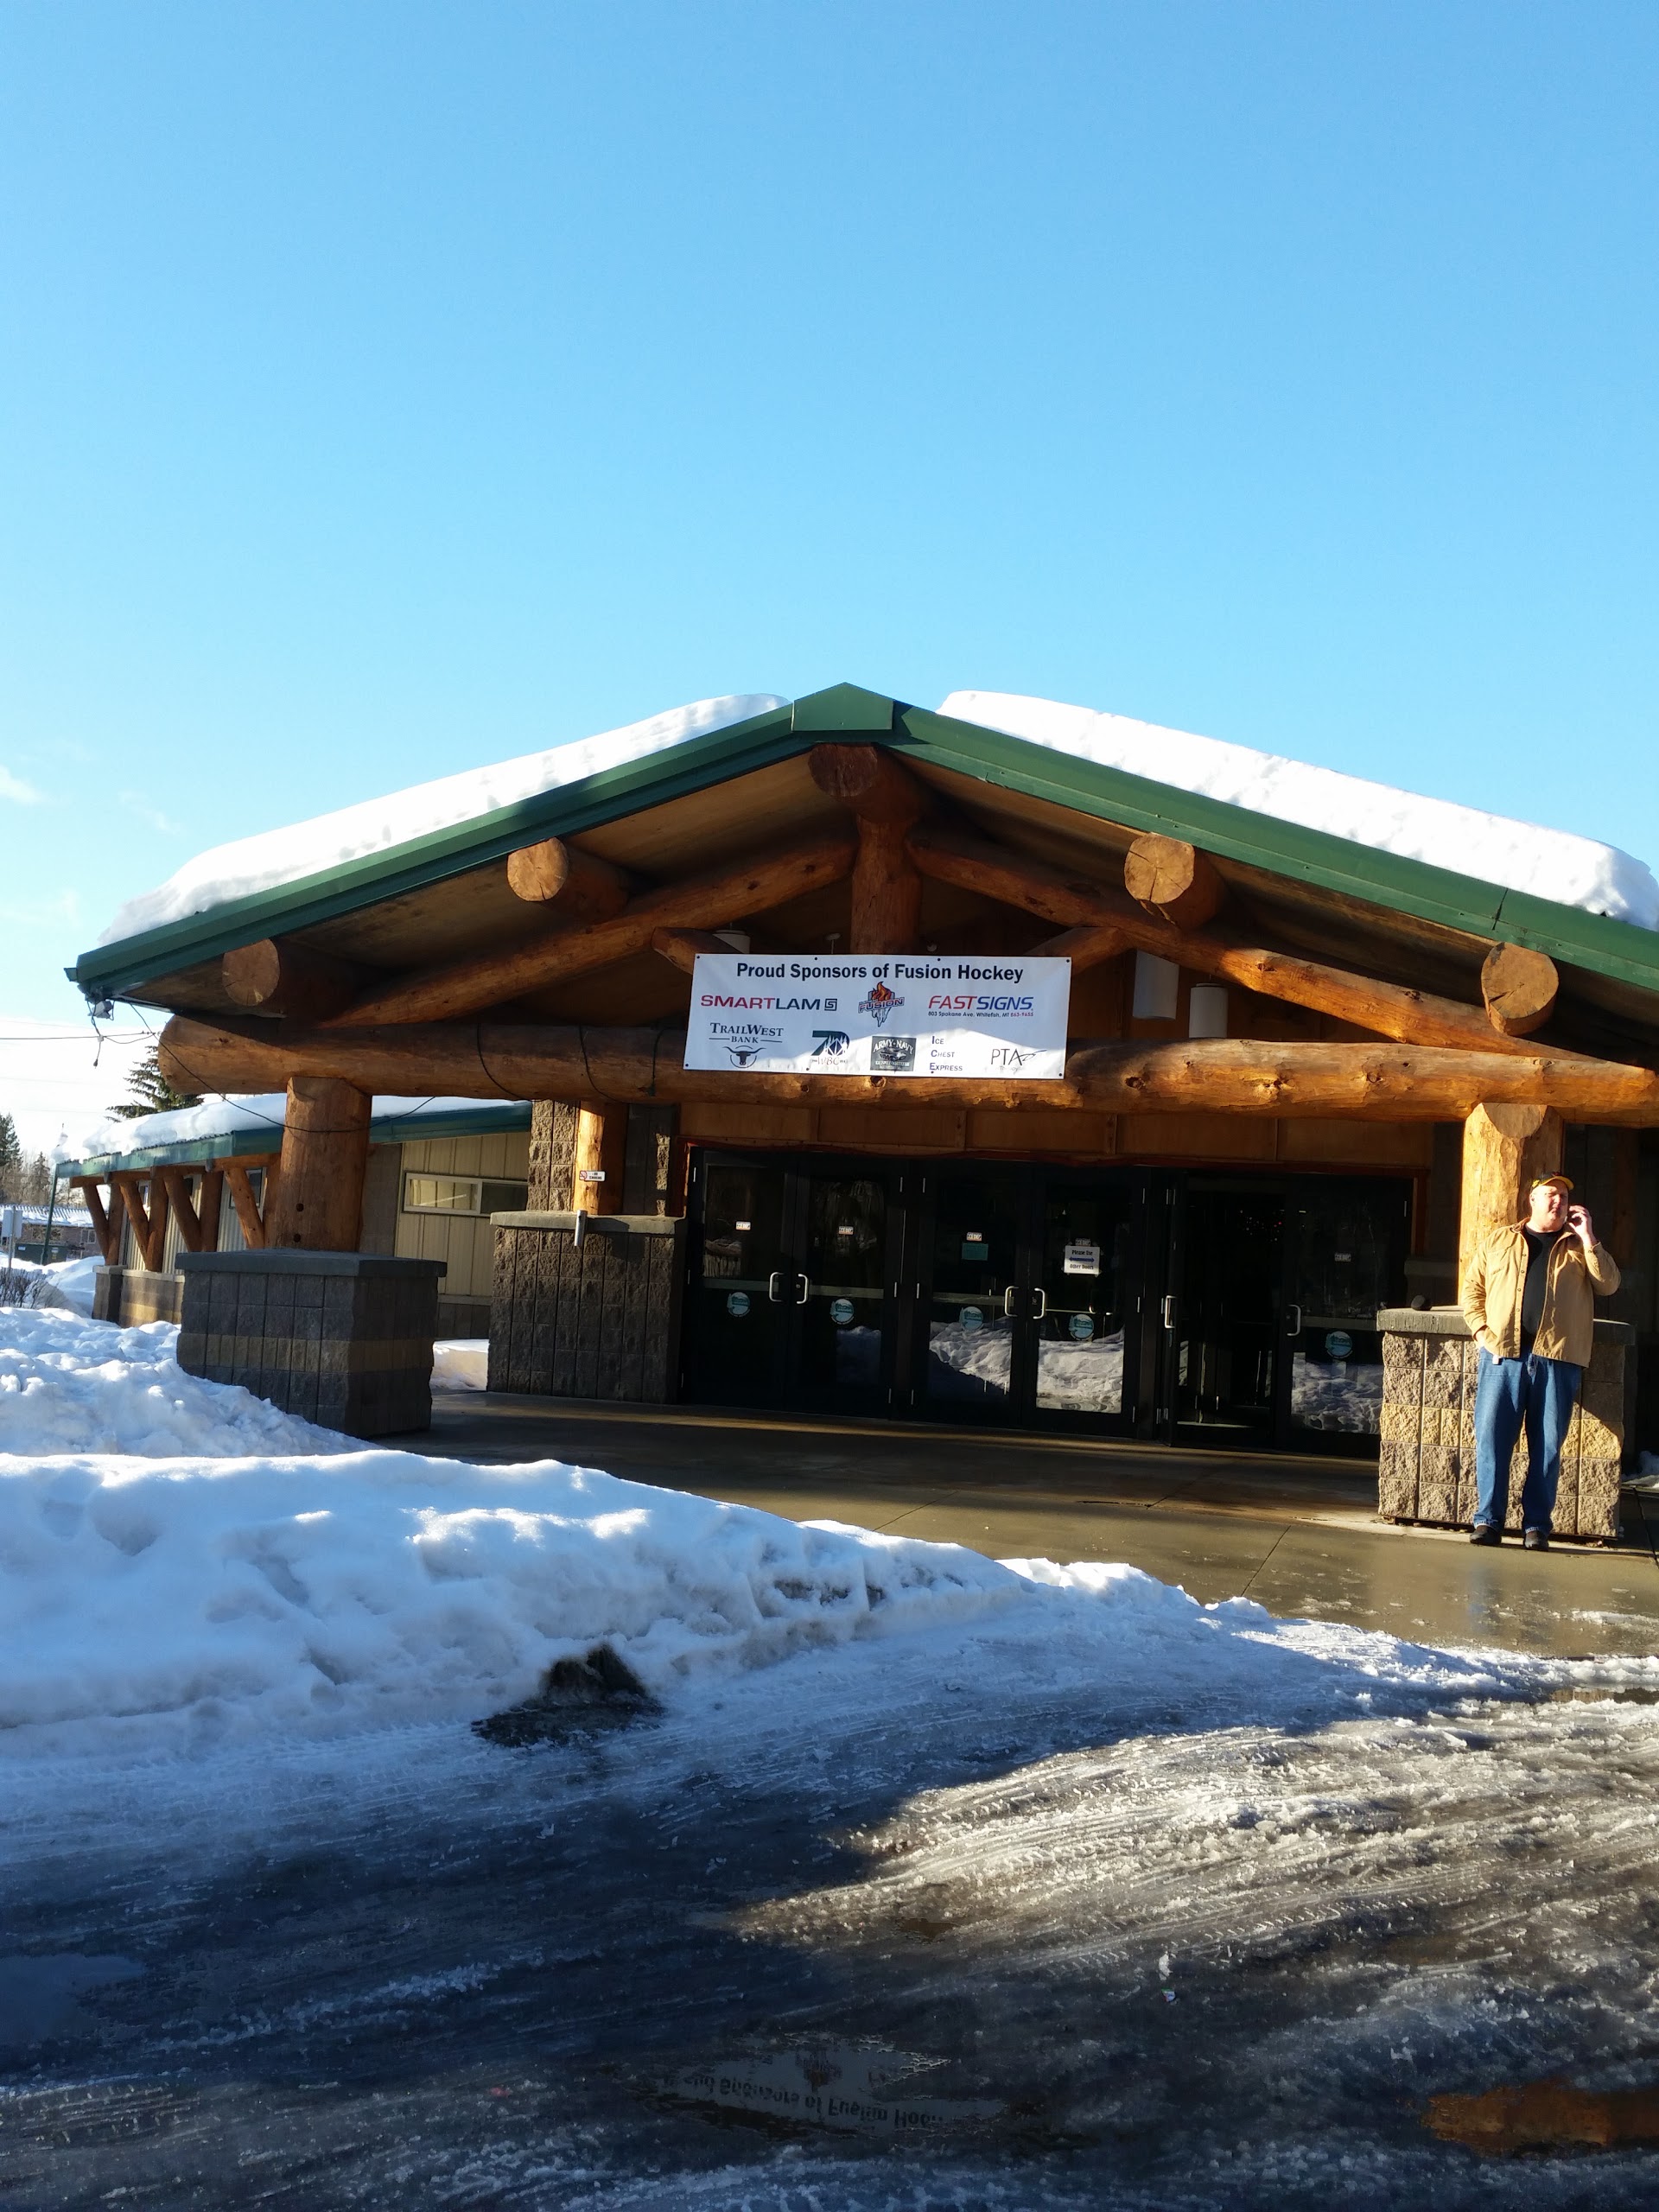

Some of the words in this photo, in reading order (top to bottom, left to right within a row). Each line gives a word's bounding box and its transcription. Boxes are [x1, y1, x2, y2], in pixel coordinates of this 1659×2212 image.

[737, 963, 785, 978] Proud
[790, 963, 867, 981] Sponsors
[872, 963, 890, 978] of
[895, 964, 950, 979] Fusion
[958, 964, 1023, 983] Hockey
[701, 995, 821, 1010] SMARTLAM
[858, 997, 905, 1014] FUSION
[928, 995, 1033, 1010] FASTSIGNS
[931, 1036, 944, 1045] ICE
[991, 1048, 1023, 1065] PTA
